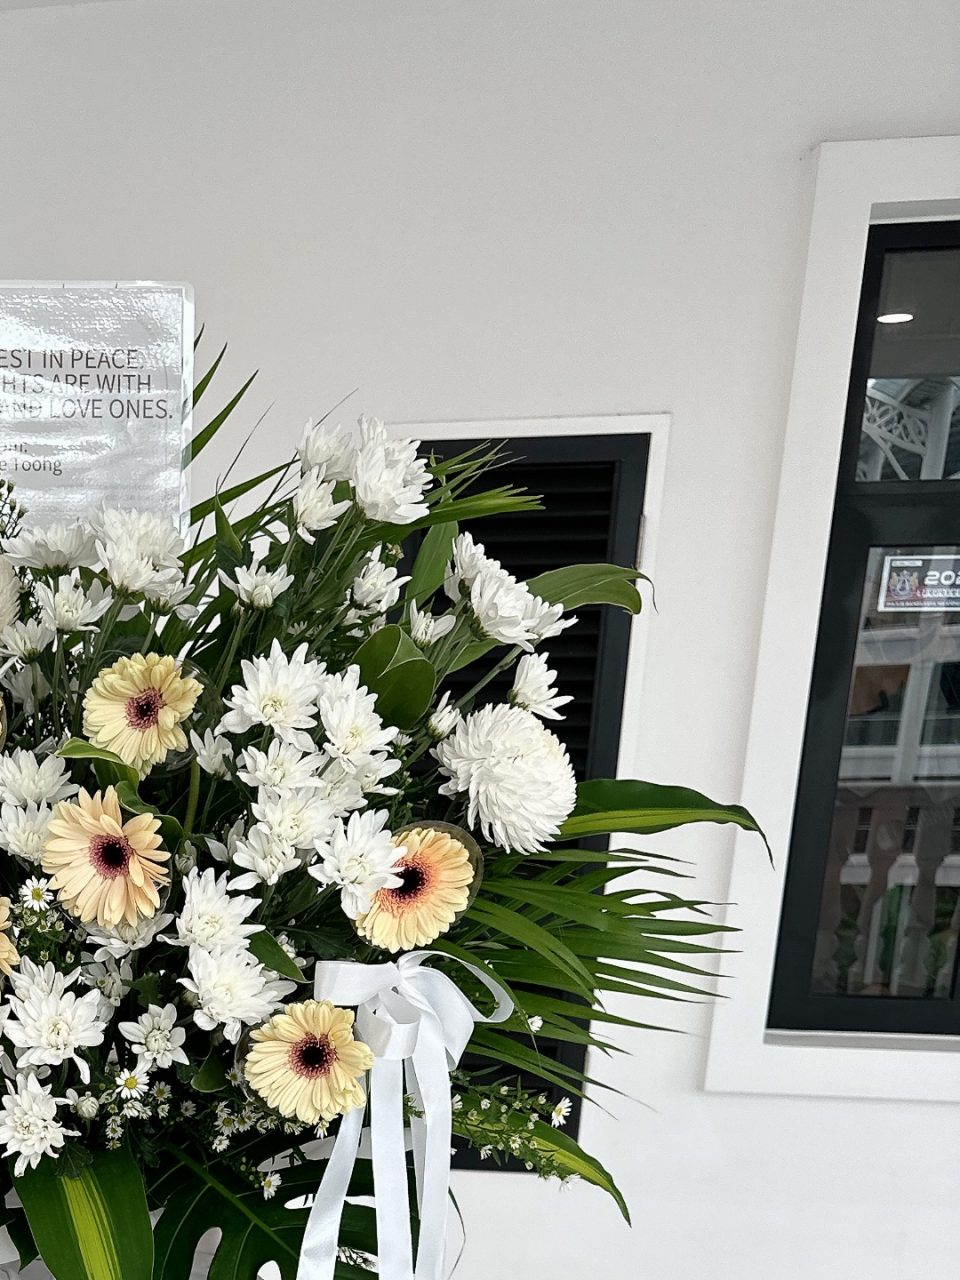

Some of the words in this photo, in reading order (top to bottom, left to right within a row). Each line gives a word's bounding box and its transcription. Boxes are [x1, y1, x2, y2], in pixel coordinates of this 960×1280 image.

[43, 349, 62, 368] IN
[50, 374, 90, 393] ARE
[96, 374, 151, 394] WITH
[0, 399, 43, 418] AND
[50, 399, 102, 418] LOVE
[110, 399, 173, 419] ONES.
